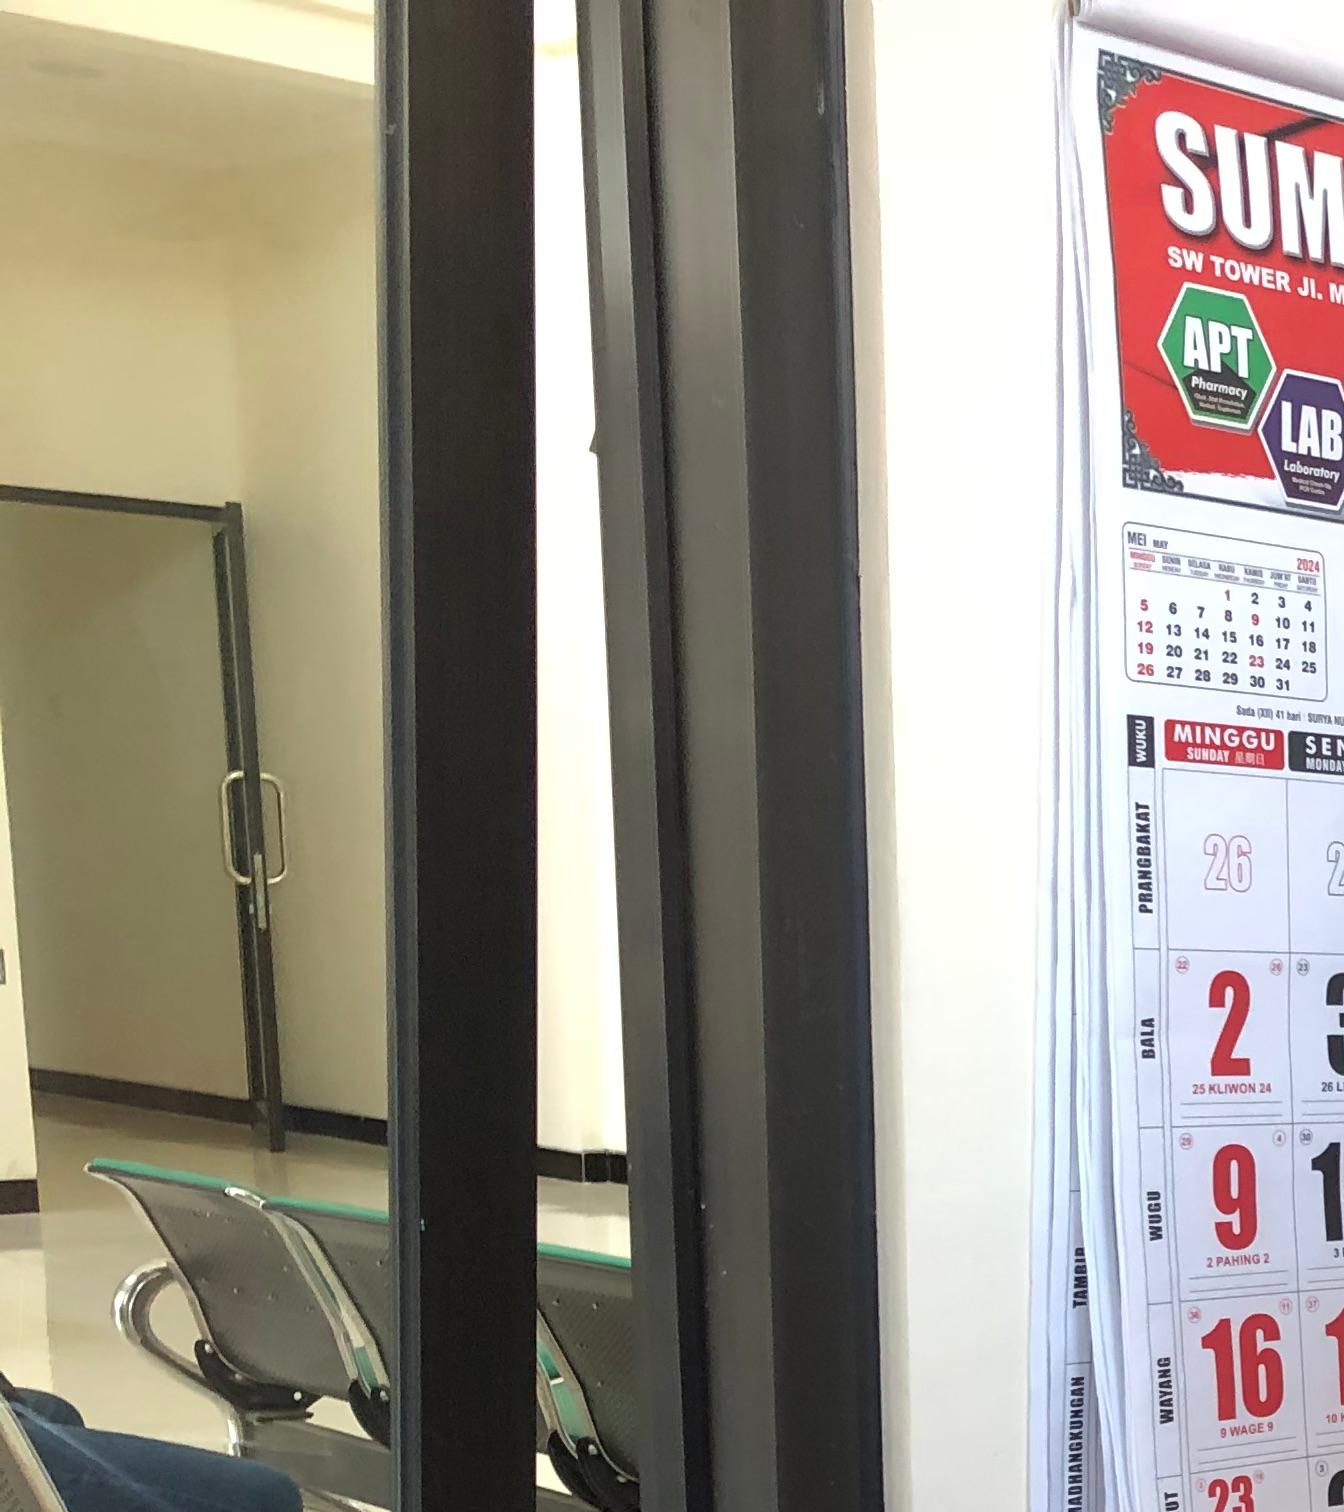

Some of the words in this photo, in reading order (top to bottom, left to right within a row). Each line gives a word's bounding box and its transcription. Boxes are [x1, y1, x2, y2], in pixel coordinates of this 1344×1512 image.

[1167, 245, 1203, 273] SW
[1211, 255, 1291, 293] TOWER
[1297, 275, 1323, 300] Jl.
[1184, 316, 1253, 378] APT
[1191, 376, 1248, 400] Pharmacy
[1281, 400, 1344, 461] LAB
[1284, 459, 1341, 483] Laboratory
[1127, 531, 1147, 547] MEI
[1296, 558, 1321, 573] 2024
[1134, 719, 1148, 763] WUKU
[1173, 723, 1276, 751] MINGGU
[1187, 746, 1230, 763] SUNDAY
[1135, 802, 1154, 914] PRANGBAKAT
[1203, 833, 1253, 893] 26
[1141, 1017, 1157, 1060] BALA
[1208, 969, 1252, 1077] 2
[1192, 1084, 1206, 1095] 25
[1208, 1083, 1257, 1095] KLIWON
[1259, 1082, 1272, 1093] 24
[1321, 1081, 1334, 1092] 26
[1147, 1190, 1163, 1241] WUGU
[1212, 1143, 1258, 1251] 9
[1159, 1356, 1175, 1424] WAYANG
[1200, 1312, 1285, 1422] 16
